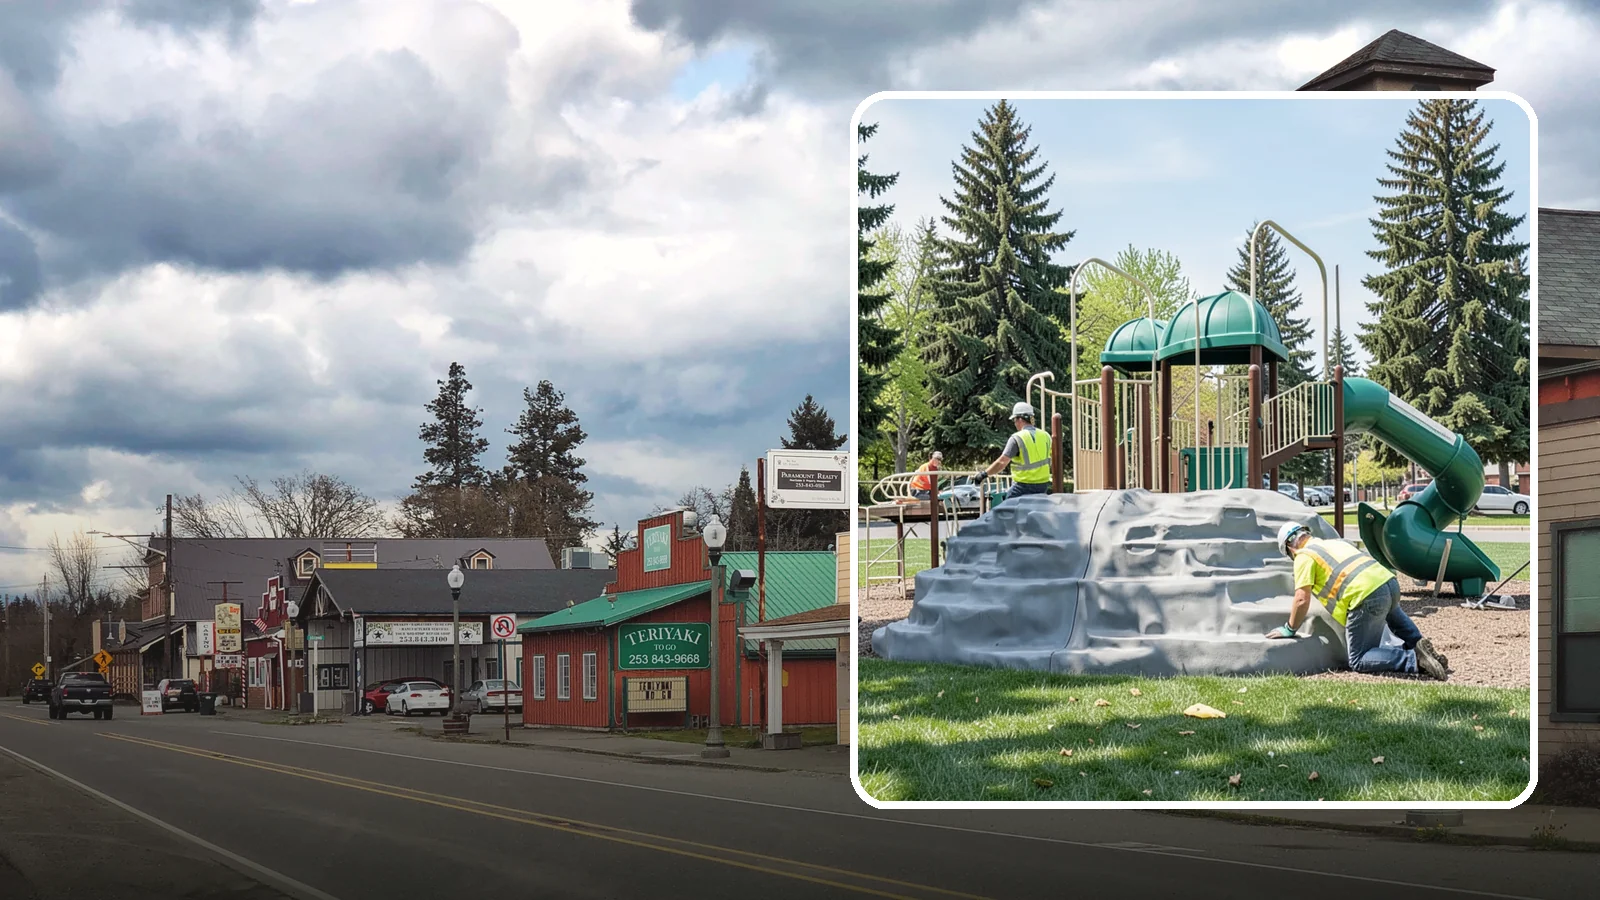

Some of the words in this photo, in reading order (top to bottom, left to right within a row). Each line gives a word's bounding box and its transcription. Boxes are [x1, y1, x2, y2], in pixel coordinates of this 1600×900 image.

[781, 471, 815, 479] PARAMOUNT
[817, 472, 839, 480] REALTY
[624, 627, 702, 646] TERIYAKI
[629, 655, 649, 664] 253
[651, 653, 700, 664] 843-9668
